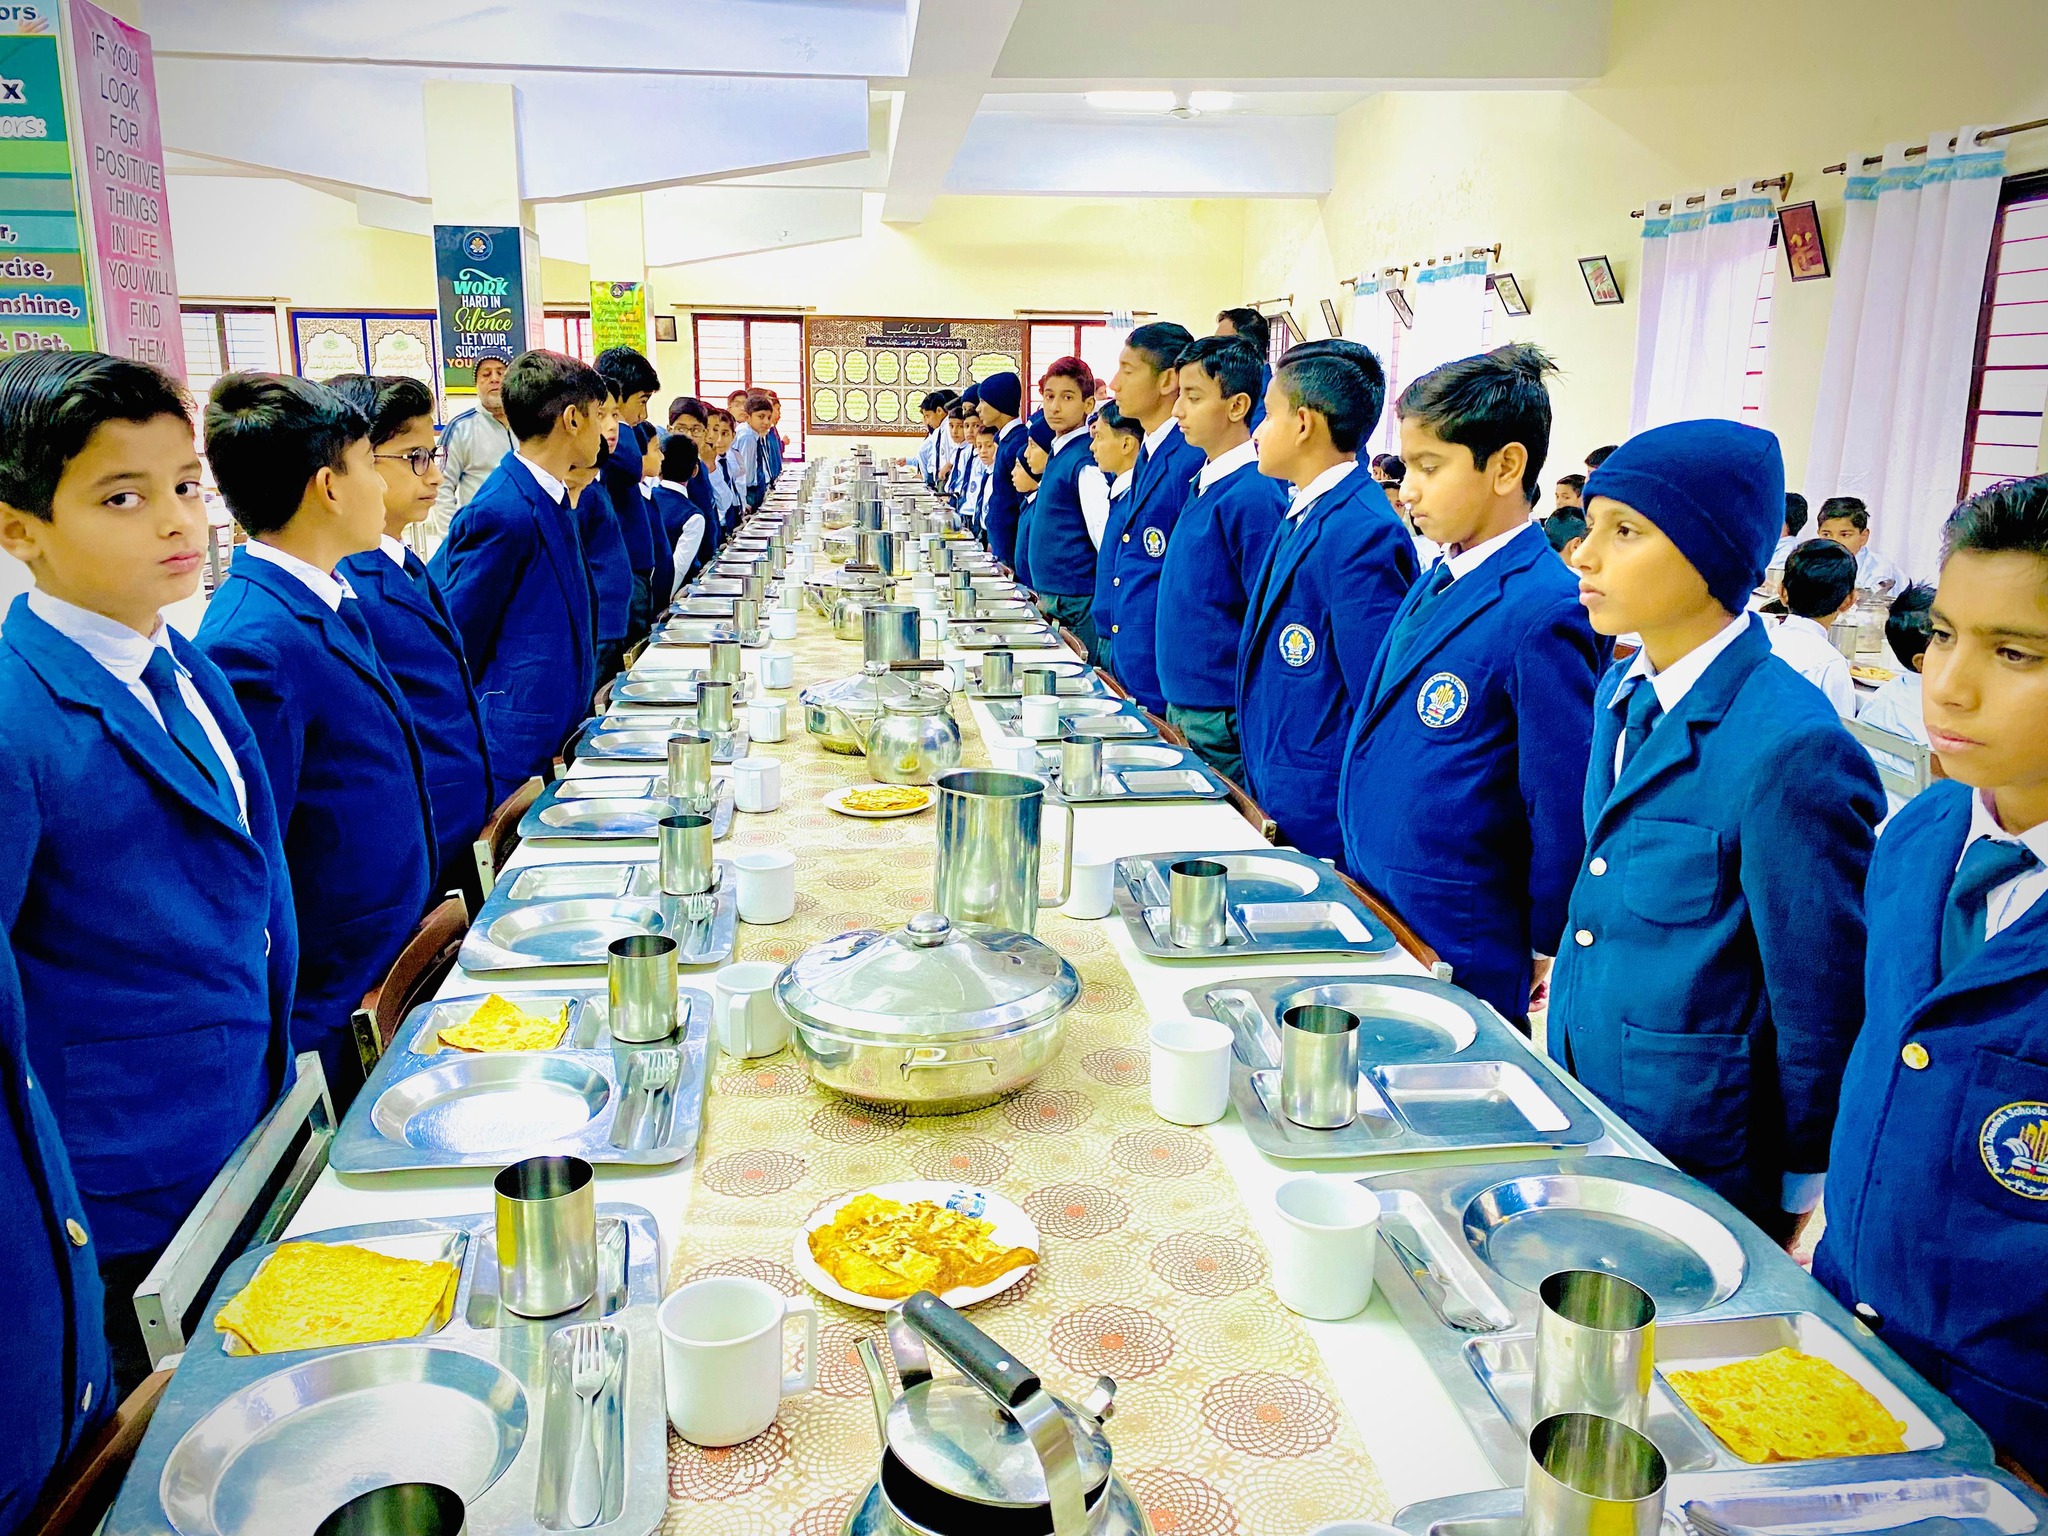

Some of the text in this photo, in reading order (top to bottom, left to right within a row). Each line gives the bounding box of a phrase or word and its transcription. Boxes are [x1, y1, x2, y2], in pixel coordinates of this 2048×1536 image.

[91, 31, 139, 76] IF YOU
[100, 73, 140, 113] LOOK
[109, 114, 140, 148] FOR
[95, 146, 160, 190] POSITIVE
[106, 186, 159, 224] THINGS
[111, 225, 162, 263] IN LIFE,
[107, 261, 173, 296] YOU WILL
[453, 268, 509, 295] WORK
[130, 302, 161, 329] FIND
[461, 295, 501, 308] HARD IN
[453, 307, 513, 333] Silence
[14, 332, 70, 352] Diet.
[128, 337, 170, 364] THEM.
[460, 333, 507, 346] LET YOUR
